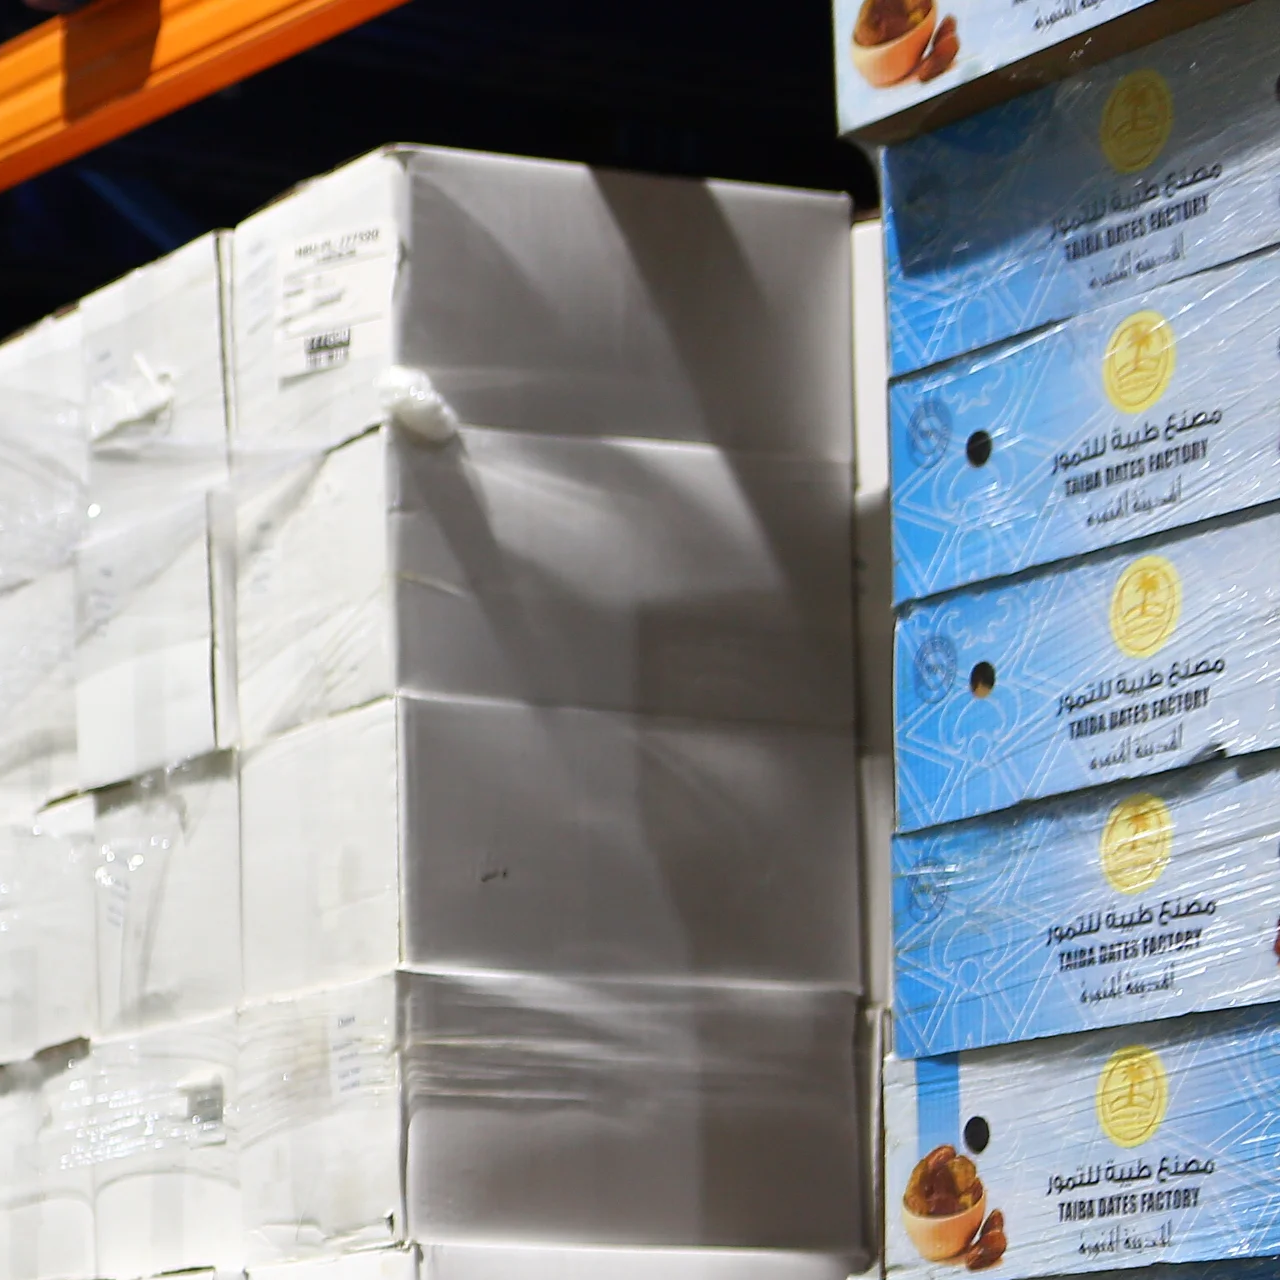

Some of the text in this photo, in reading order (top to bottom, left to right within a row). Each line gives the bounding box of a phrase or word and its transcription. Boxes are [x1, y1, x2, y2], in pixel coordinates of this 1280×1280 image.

[1164, 409, 1223, 441] مصنع
[1050, 434, 1107, 476] للتمور
[1065, 437, 1209, 497] TAIBA DATES FACTORY
[1169, 658, 1226, 688] مصنع
[1056, 683, 1112, 717] للتمور
[1069, 686, 1211, 740] TAIBA DATES FACTORY
[1159, 898, 1217, 926] مصنع
[1046, 912, 1102, 947] للتمور
[1059, 928, 1202, 973] TAIBA DATES FACTORY
[1046, 1163, 1101, 1197] للتمور
[1157, 1154, 1216, 1183] مصنع
[1058, 1187, 1200, 1223] TAIBA DATES FACTORY
